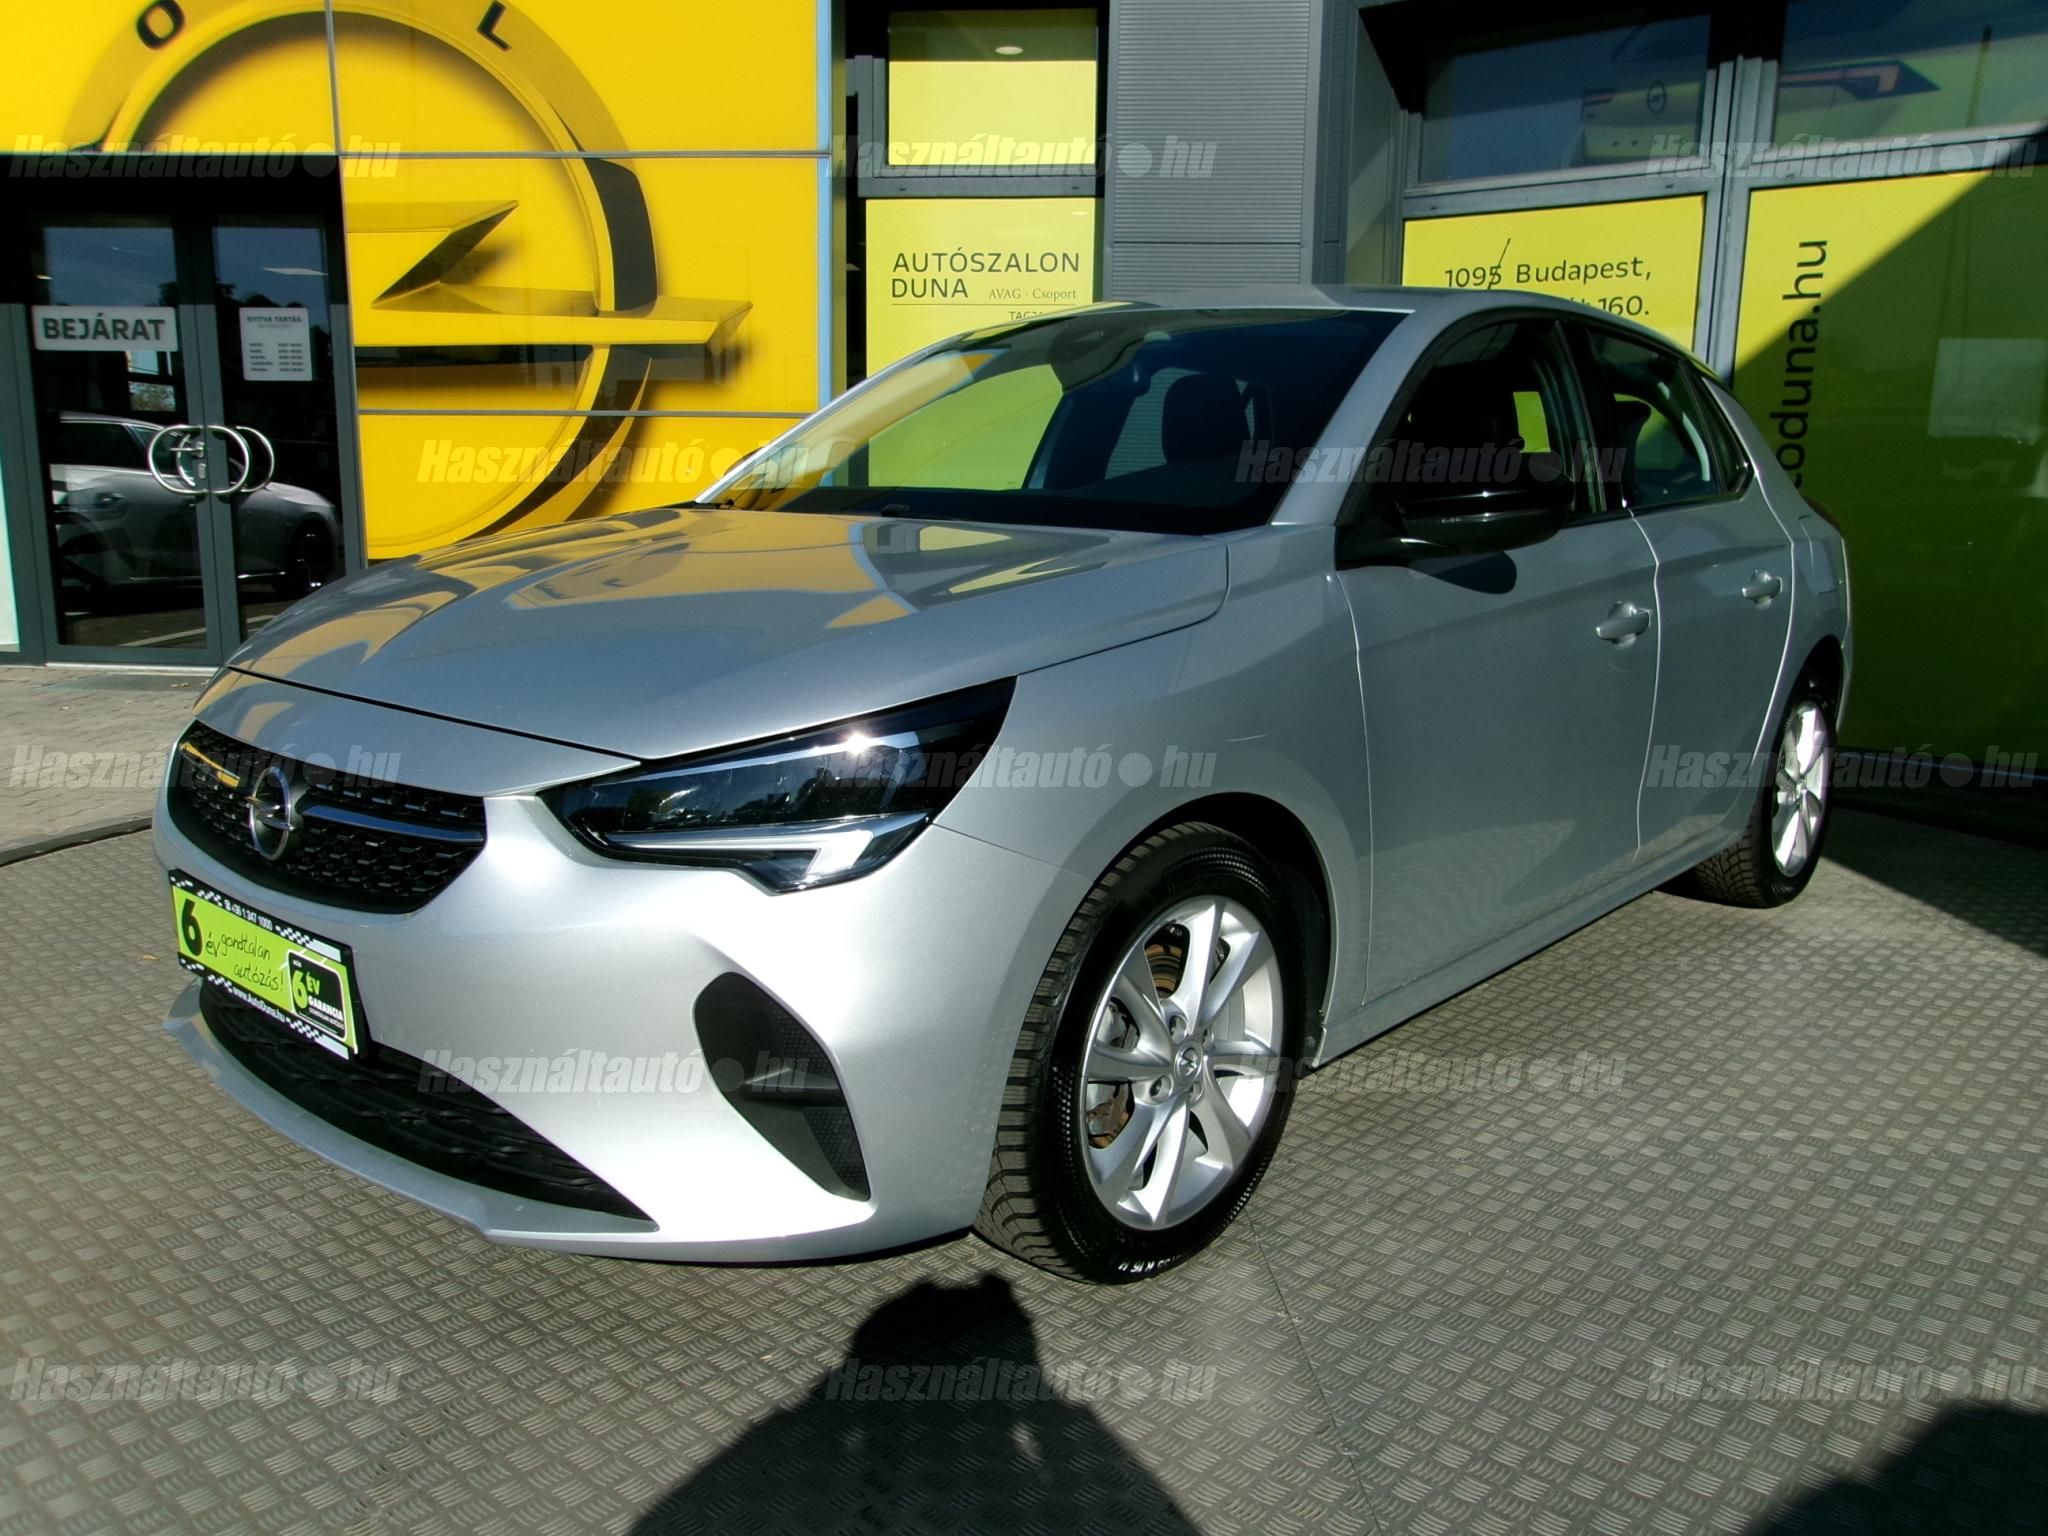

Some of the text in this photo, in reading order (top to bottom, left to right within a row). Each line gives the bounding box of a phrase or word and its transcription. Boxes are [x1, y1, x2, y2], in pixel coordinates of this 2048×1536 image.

[892, 247, 1079, 272] AUTÓSZALON
[1444, 256, 1652, 288] 1095 Budapest,
[892, 278, 969, 298] DUNA
[988, 287, 1076, 302] AVAG Csoport
[1598, 295, 1650, 316] 160.
[43, 313, 165, 340] BEJÁRAT
